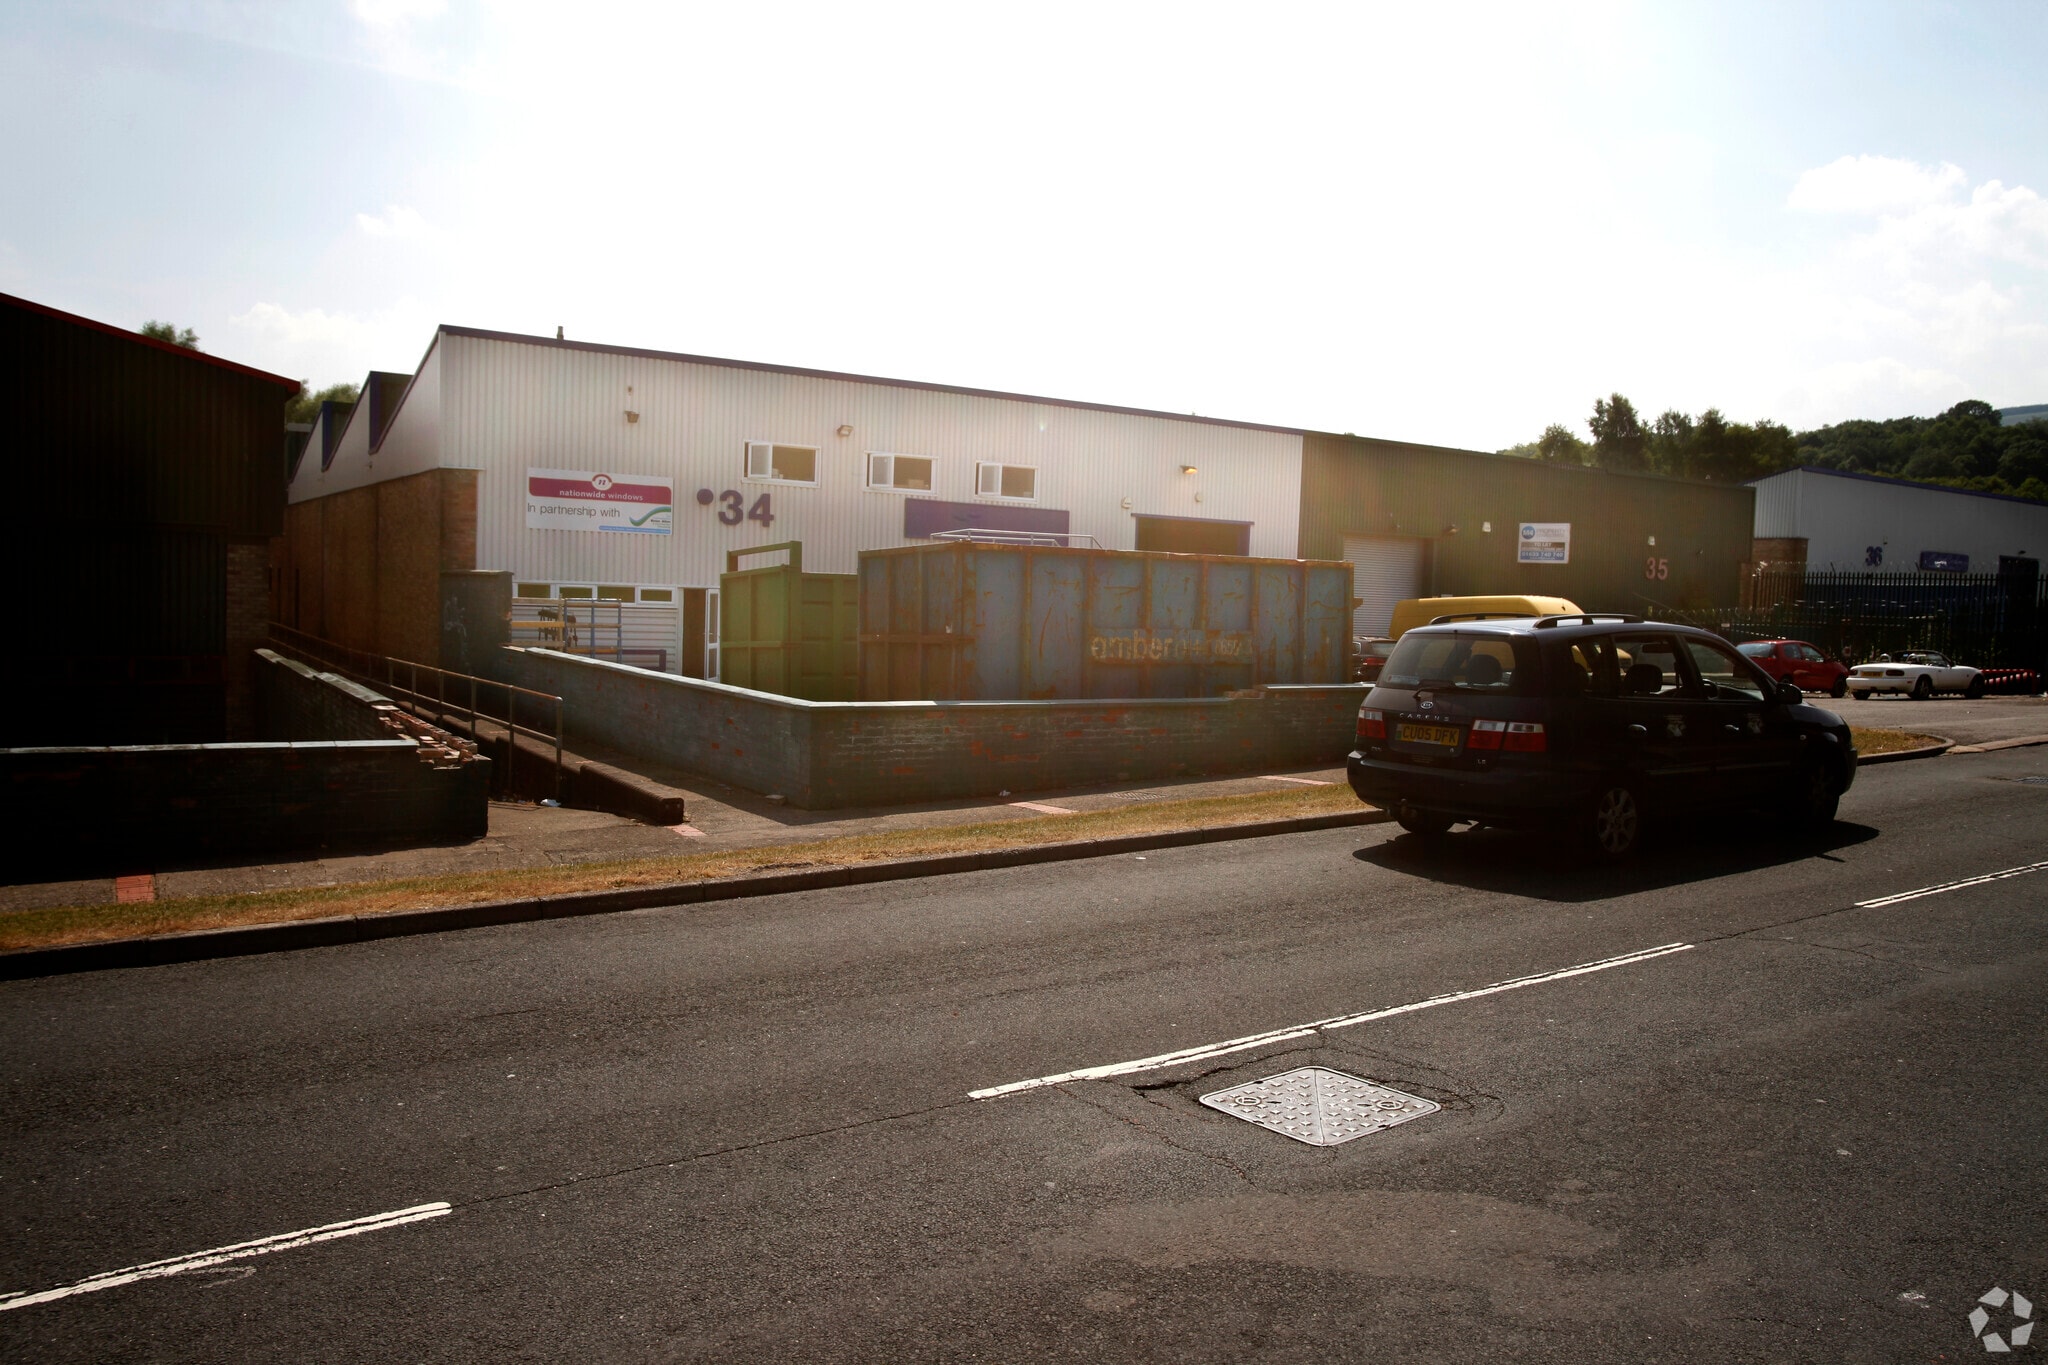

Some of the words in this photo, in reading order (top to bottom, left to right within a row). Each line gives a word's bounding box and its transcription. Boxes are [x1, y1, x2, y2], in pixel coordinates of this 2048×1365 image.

[559, 489, 606, 500] nationwide
[607, 491, 644, 502] windows
[527, 502, 537, 513] In
[539, 504, 597, 518] partnership
[600, 506, 621, 518] with
[718, 489, 775, 527] 34
[1865, 546, 1883, 567] 36
[1645, 557, 1668, 581] 35
[1402, 725, 1432, 741] CU05
[1433, 727, 1458, 744] DFK
